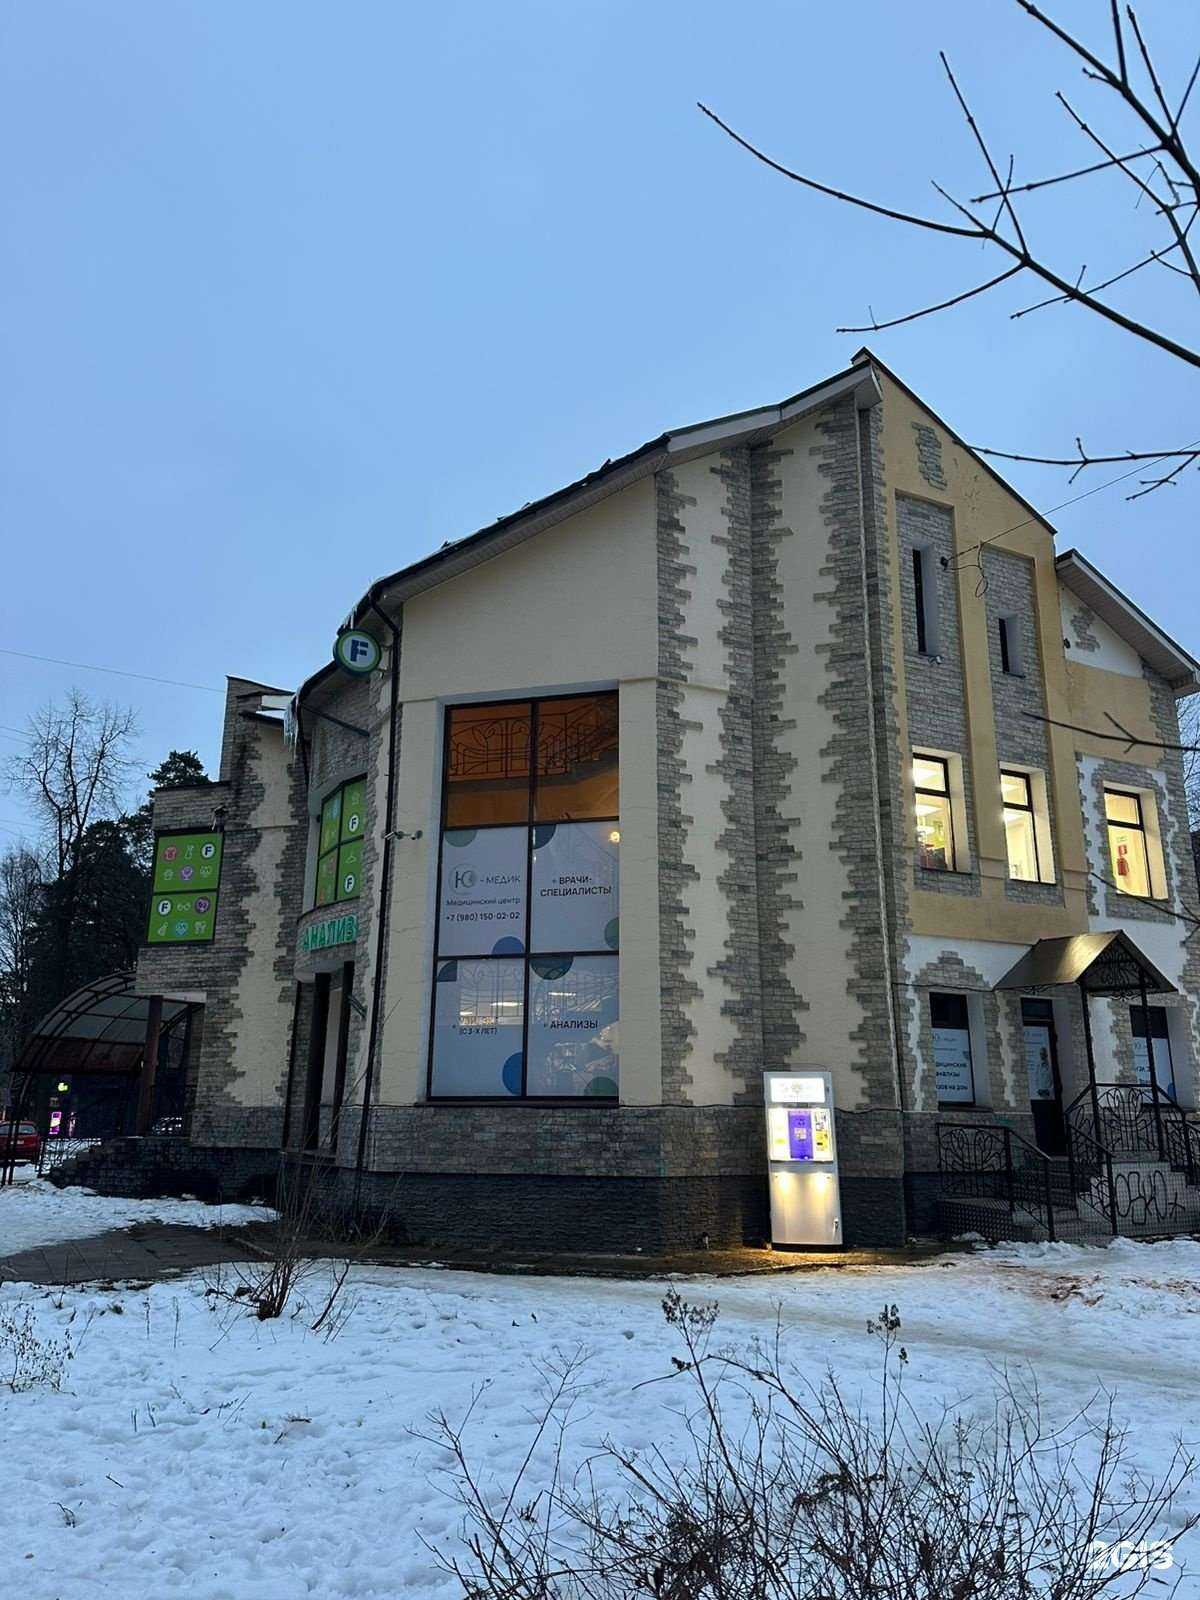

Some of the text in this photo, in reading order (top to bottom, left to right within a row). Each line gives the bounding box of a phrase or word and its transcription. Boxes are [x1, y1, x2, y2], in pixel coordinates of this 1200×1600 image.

[351, 639, 369, 662] F
[540, 885, 612, 897] СПЕЦИАЛИСТЫ
[550, 1020, 598, 1029] АНАЛИЗЫ
